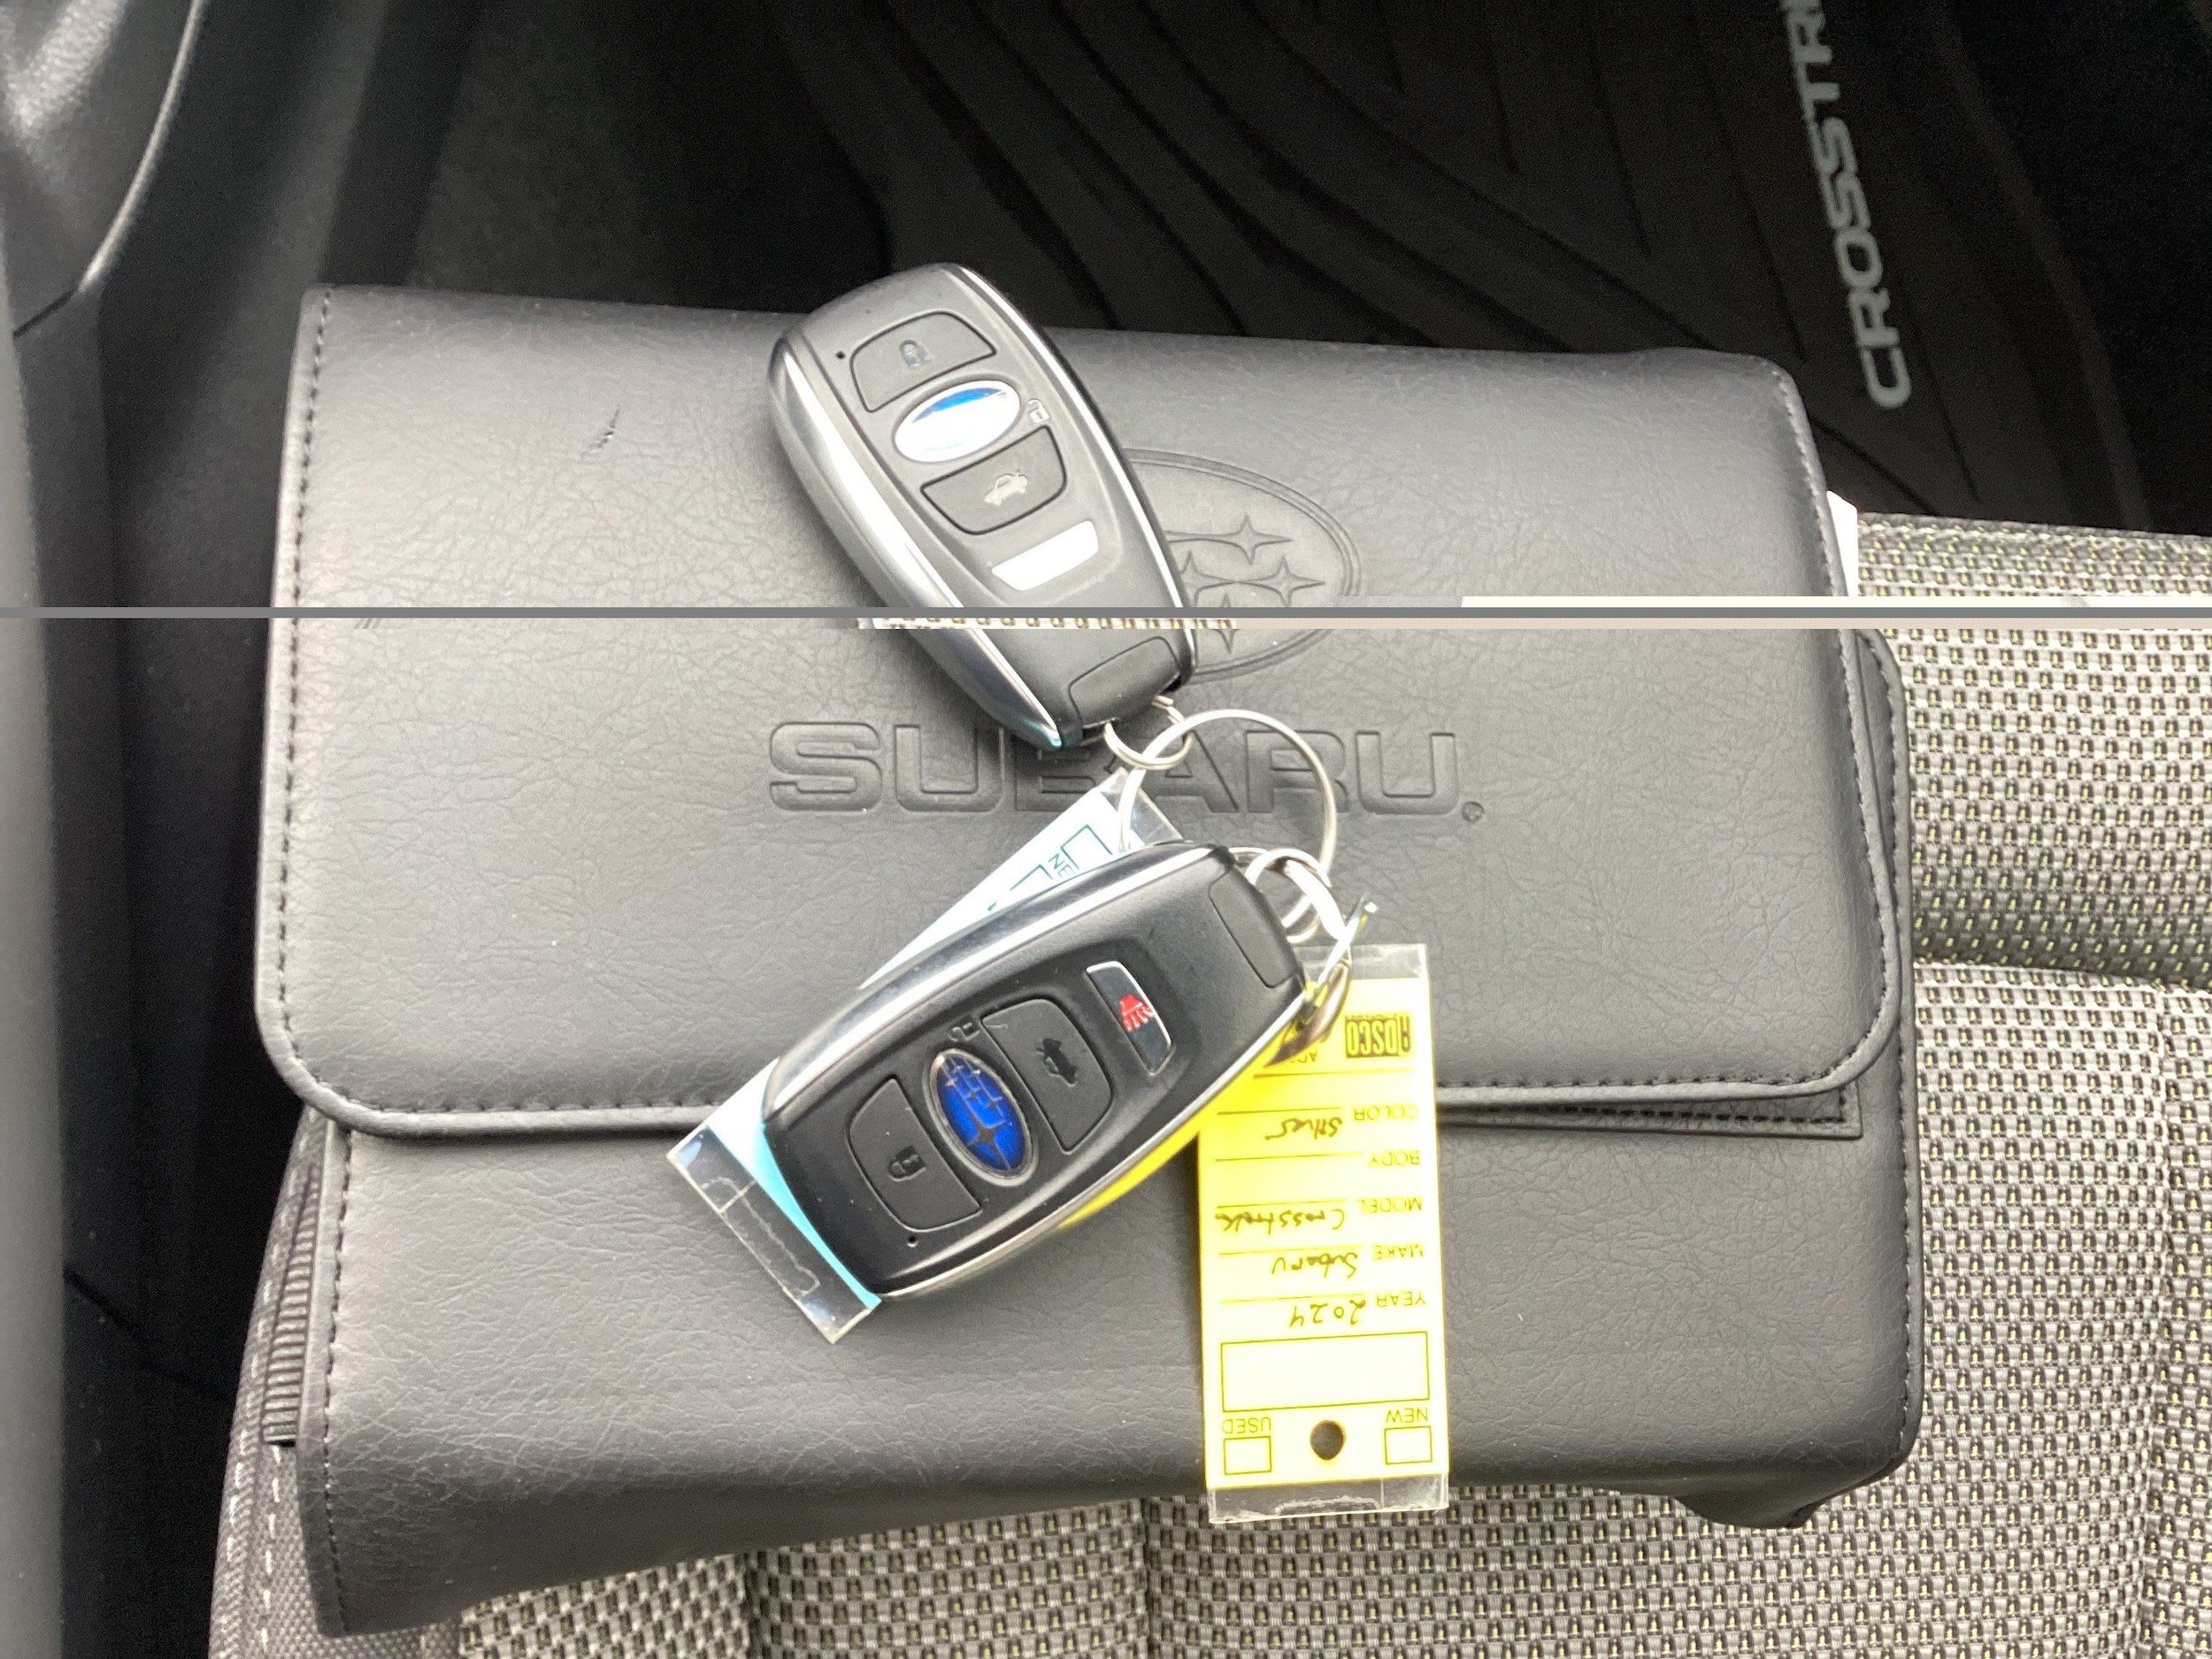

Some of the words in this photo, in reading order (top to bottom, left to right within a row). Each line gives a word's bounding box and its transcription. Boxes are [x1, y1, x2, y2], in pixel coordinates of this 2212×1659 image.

[1779, 0, 1911, 408] CROSSTR
[1048, 853, 1077, 879] NE
[1371, 1150, 1420, 1166] BODY
[1360, 1198, 1423, 1213] MODEL
[1372, 1244, 1424, 1260] MAKE
[1376, 1291, 1426, 1308] YEAR
[1289, 1299, 1366, 1327] 2024
[1386, 1408, 1428, 1424] NEW
[1222, 1417, 1272, 1434] USED
